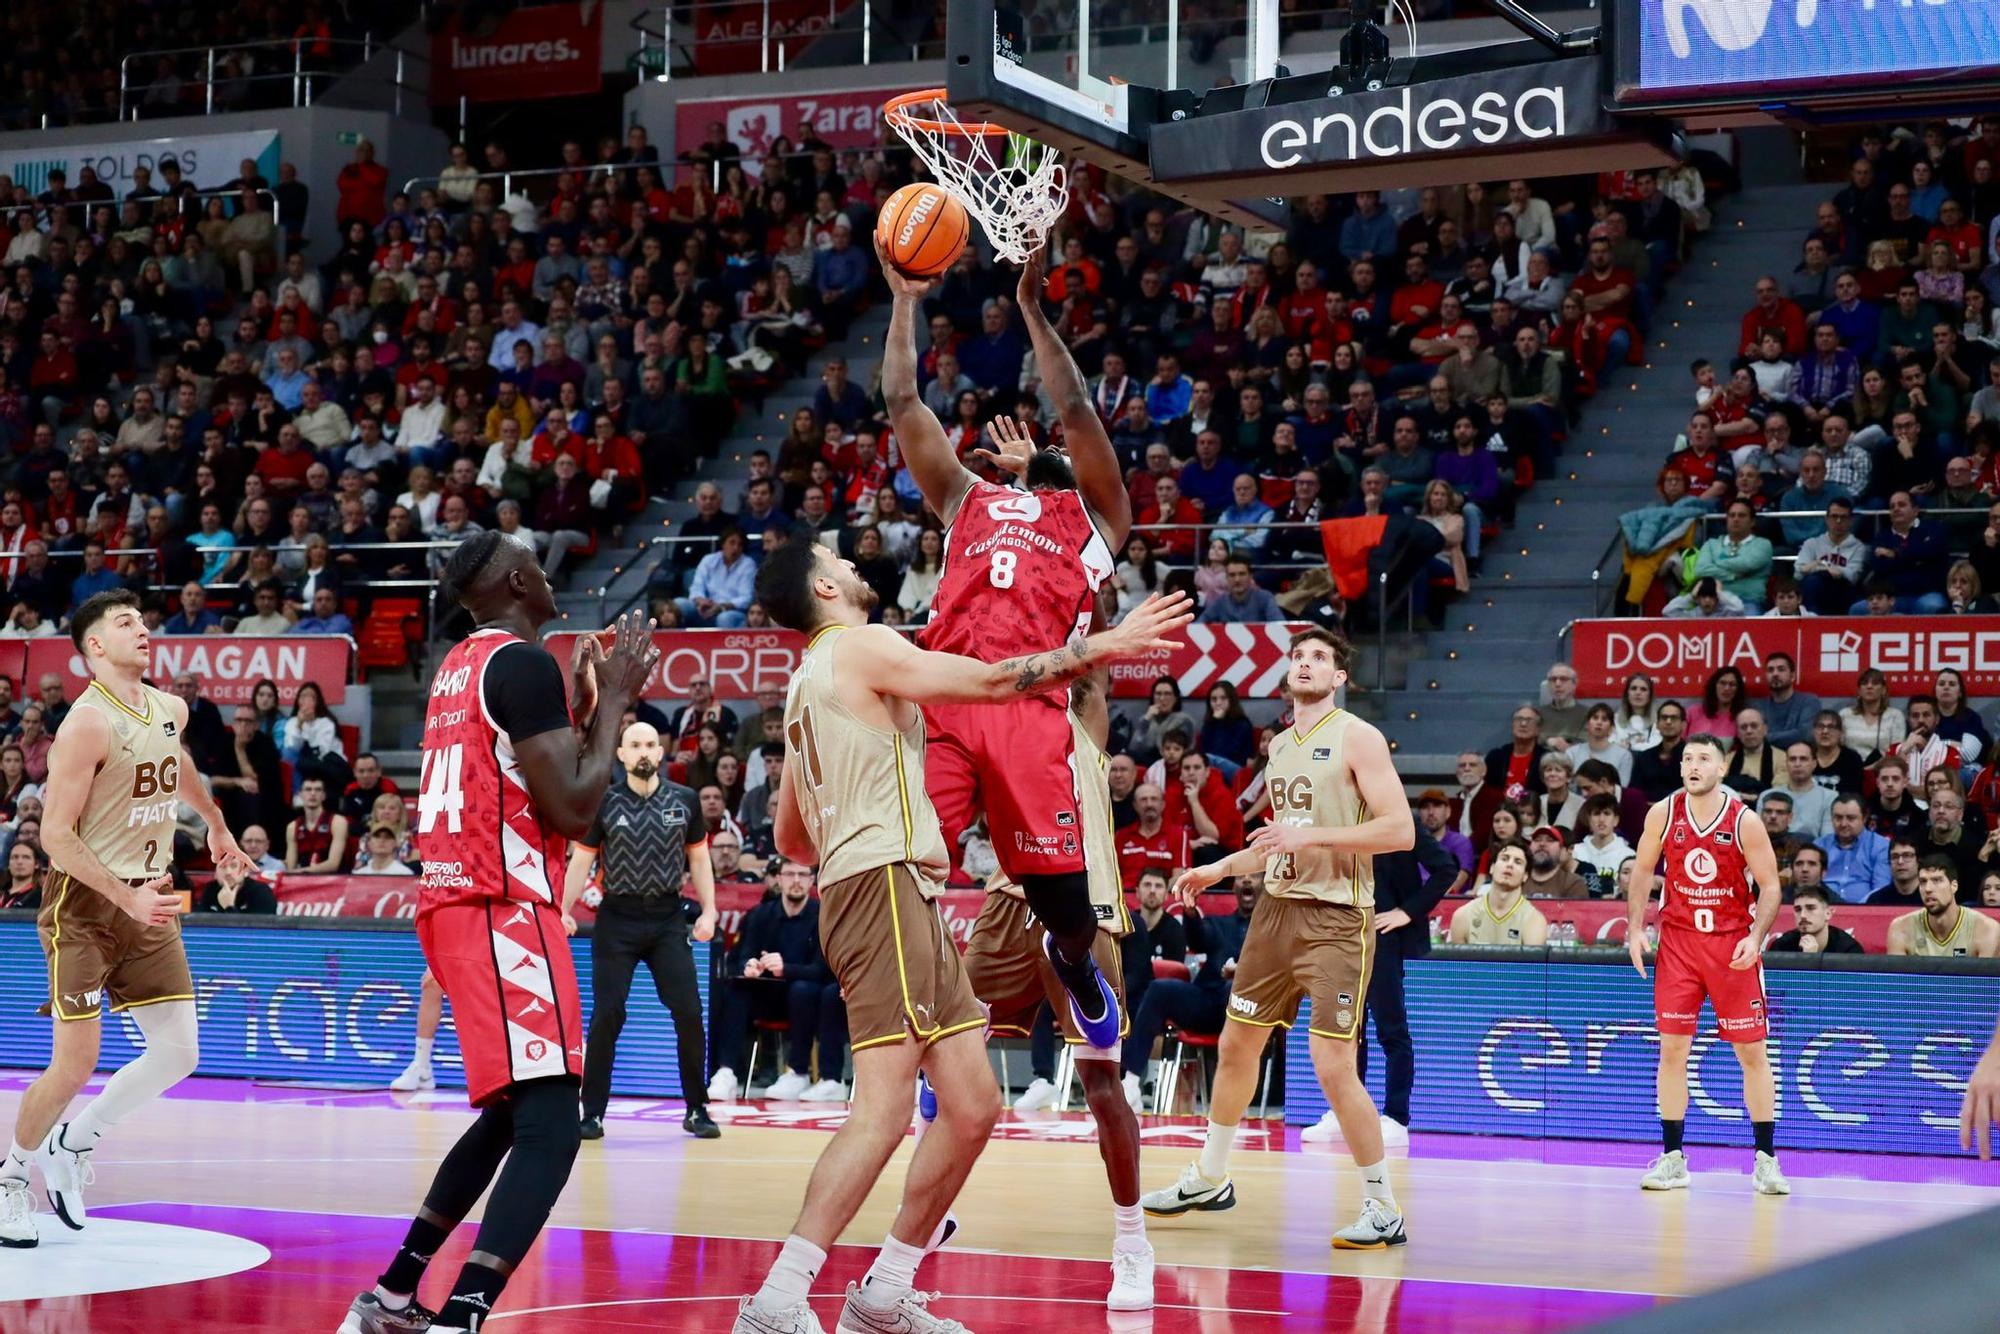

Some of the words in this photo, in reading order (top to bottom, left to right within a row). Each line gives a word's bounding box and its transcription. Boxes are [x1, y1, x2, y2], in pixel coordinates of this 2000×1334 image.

[1260, 86, 1565, 169] endesa
[899, 192, 939, 246] Wilson
[990, 550, 1017, 589] 8
[725, 635, 778, 648] GRUPO
[1607, 632, 1761, 669] DOMIA
[132, 755, 177, 799] BG
[418, 743, 464, 833] 44
[1270, 774, 1313, 811] BG
[144, 839, 160, 873] 2
[1694, 908, 1714, 932] 0
